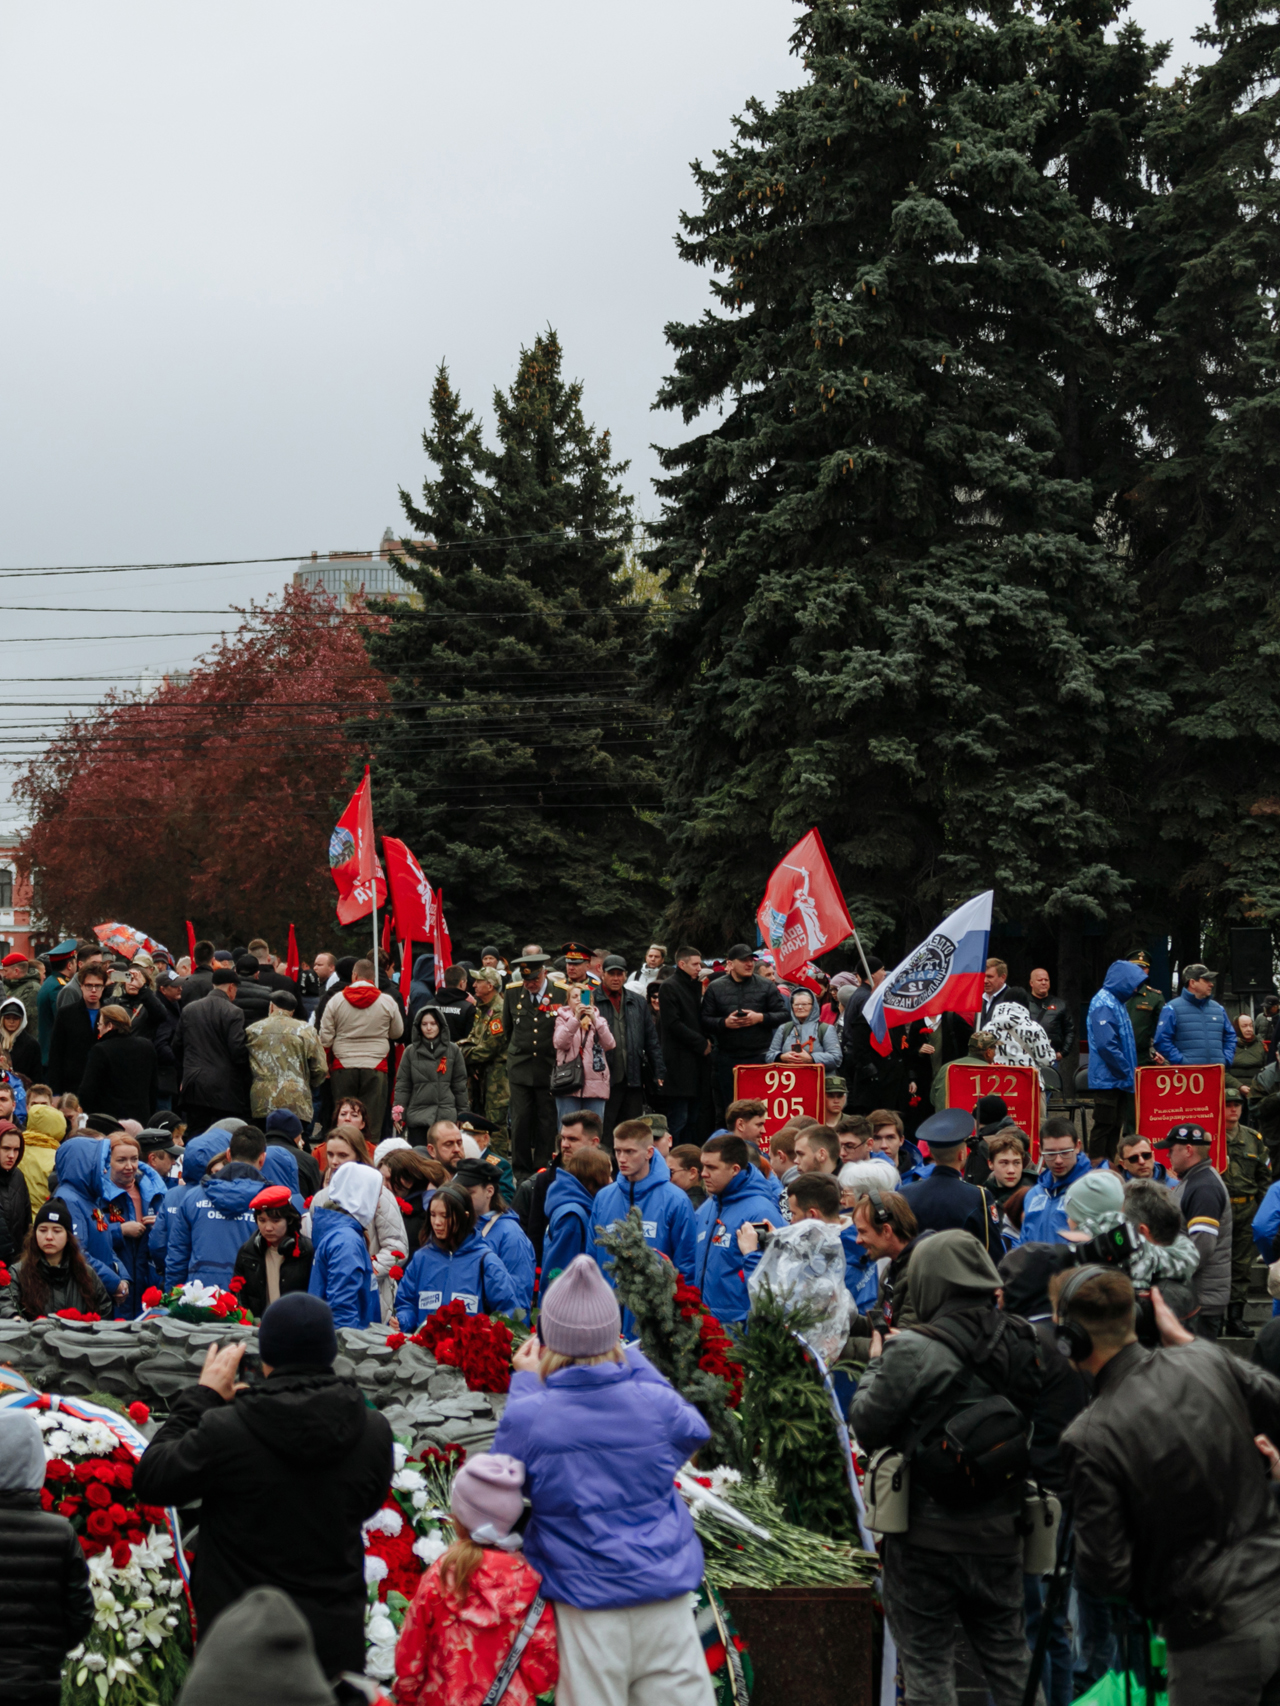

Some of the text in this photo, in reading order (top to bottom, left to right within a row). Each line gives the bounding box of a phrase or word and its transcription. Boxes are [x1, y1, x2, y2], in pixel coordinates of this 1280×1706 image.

[765, 1070, 796, 1094] 99
[969, 1074, 1018, 1097] 122
[1156, 1073, 1205, 1097] 990
[761, 1097, 805, 1120] 105
[1114, 1231, 1124, 1246] 6
